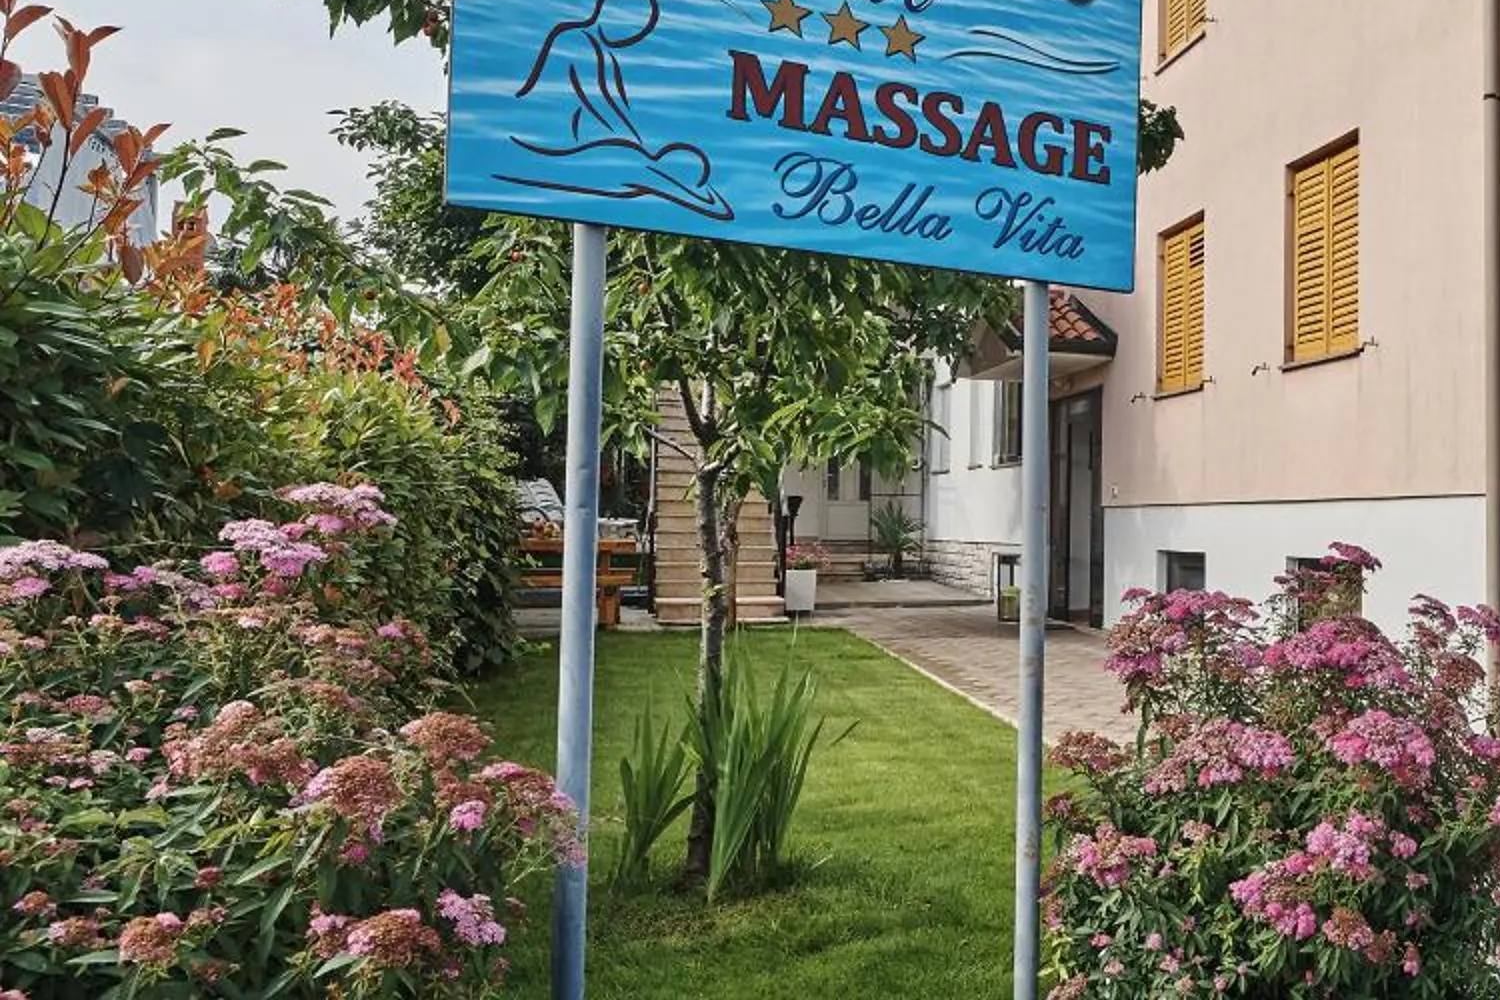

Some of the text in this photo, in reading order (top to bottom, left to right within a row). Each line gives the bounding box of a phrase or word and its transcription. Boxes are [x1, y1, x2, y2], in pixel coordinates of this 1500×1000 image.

[726, 49, 1112, 185] MASSAGE
[772, 151, 1085, 261] Bella Vita
